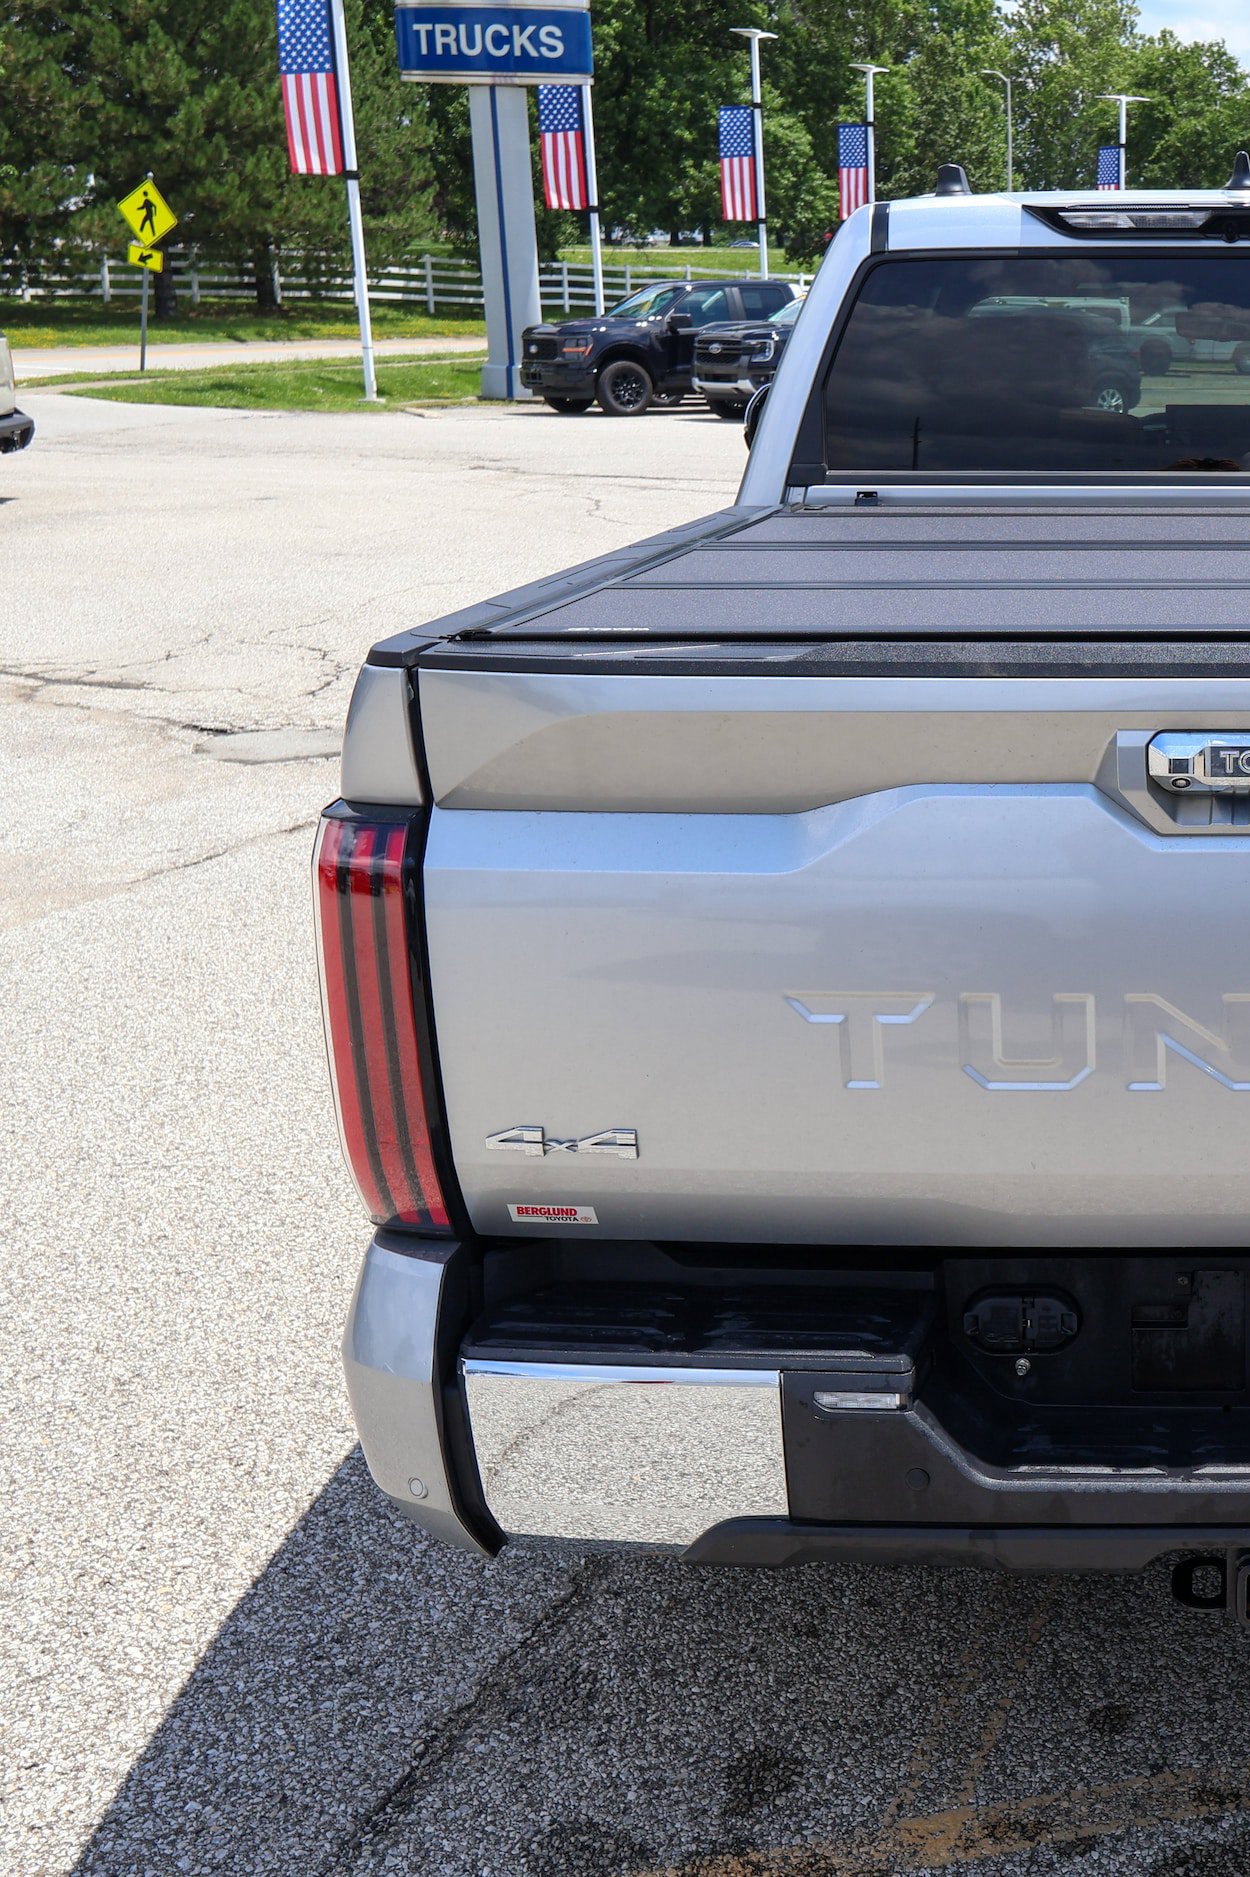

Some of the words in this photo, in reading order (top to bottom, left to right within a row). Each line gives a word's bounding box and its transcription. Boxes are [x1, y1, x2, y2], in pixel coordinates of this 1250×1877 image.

[412, 23, 565, 59] TRUCKS
[485, 1126, 640, 1160] 4x4
[516, 1206, 578, 1217] BERGLUND
